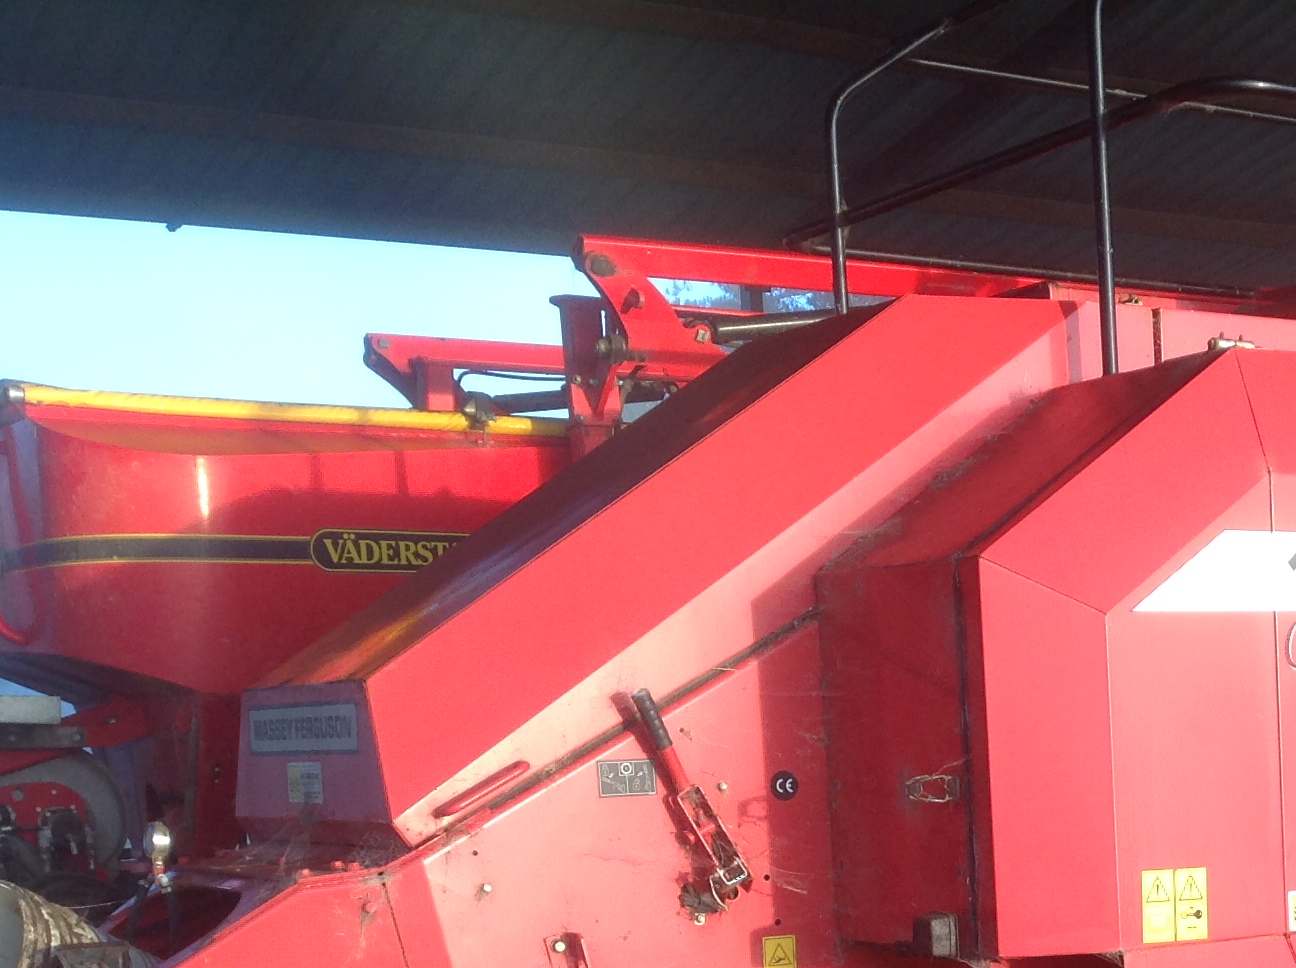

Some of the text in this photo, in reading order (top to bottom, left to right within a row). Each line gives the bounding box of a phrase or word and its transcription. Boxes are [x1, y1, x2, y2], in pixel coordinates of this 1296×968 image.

[322, 533, 457, 566] VÄDERST
[253, 715, 352, 741] MASSEY FERGUSON
[775, 777, 794, 793] CE
